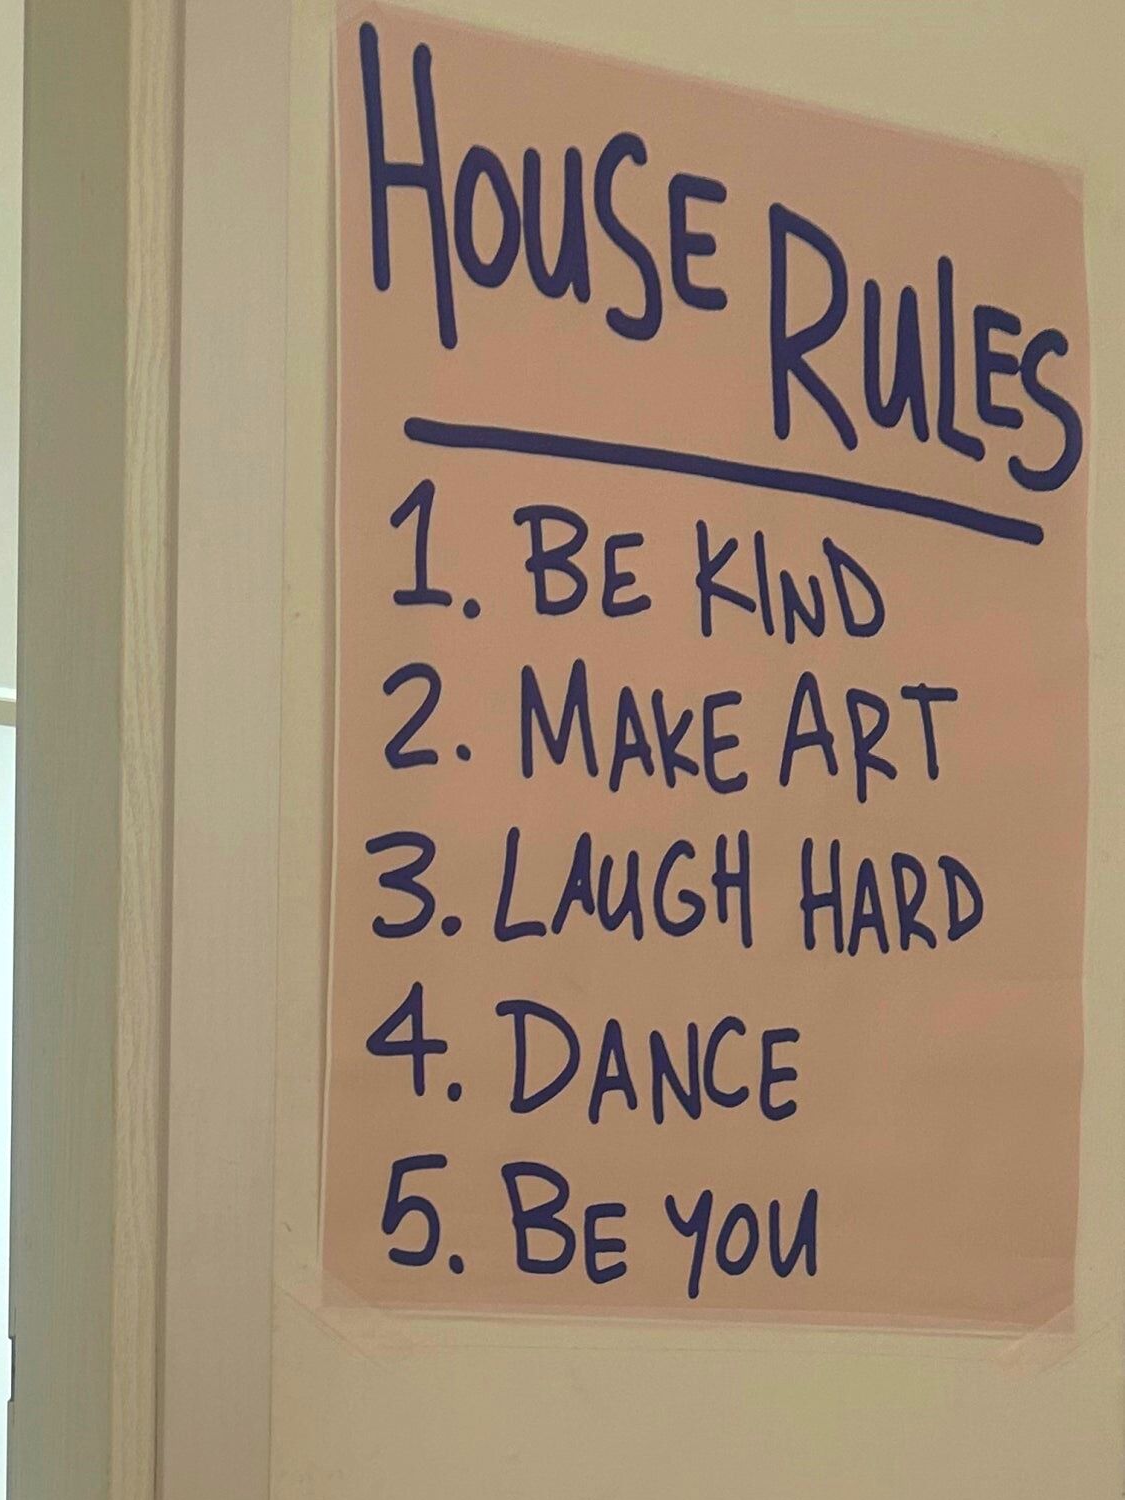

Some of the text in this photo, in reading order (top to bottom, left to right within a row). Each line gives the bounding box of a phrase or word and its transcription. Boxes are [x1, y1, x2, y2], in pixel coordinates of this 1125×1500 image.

[357, 20, 1085, 494] HOUSE RULES
[388, 477, 887, 646] 1. BE KIND
[381, 657, 960, 806] 2. MAKE ART
[363, 825, 985, 959] 3. LAUGH HARD
[364, 979, 802, 1127] 4. DANCE
[379, 1152, 466, 1276] 5.
[499, 1159, 629, 1286] BE
